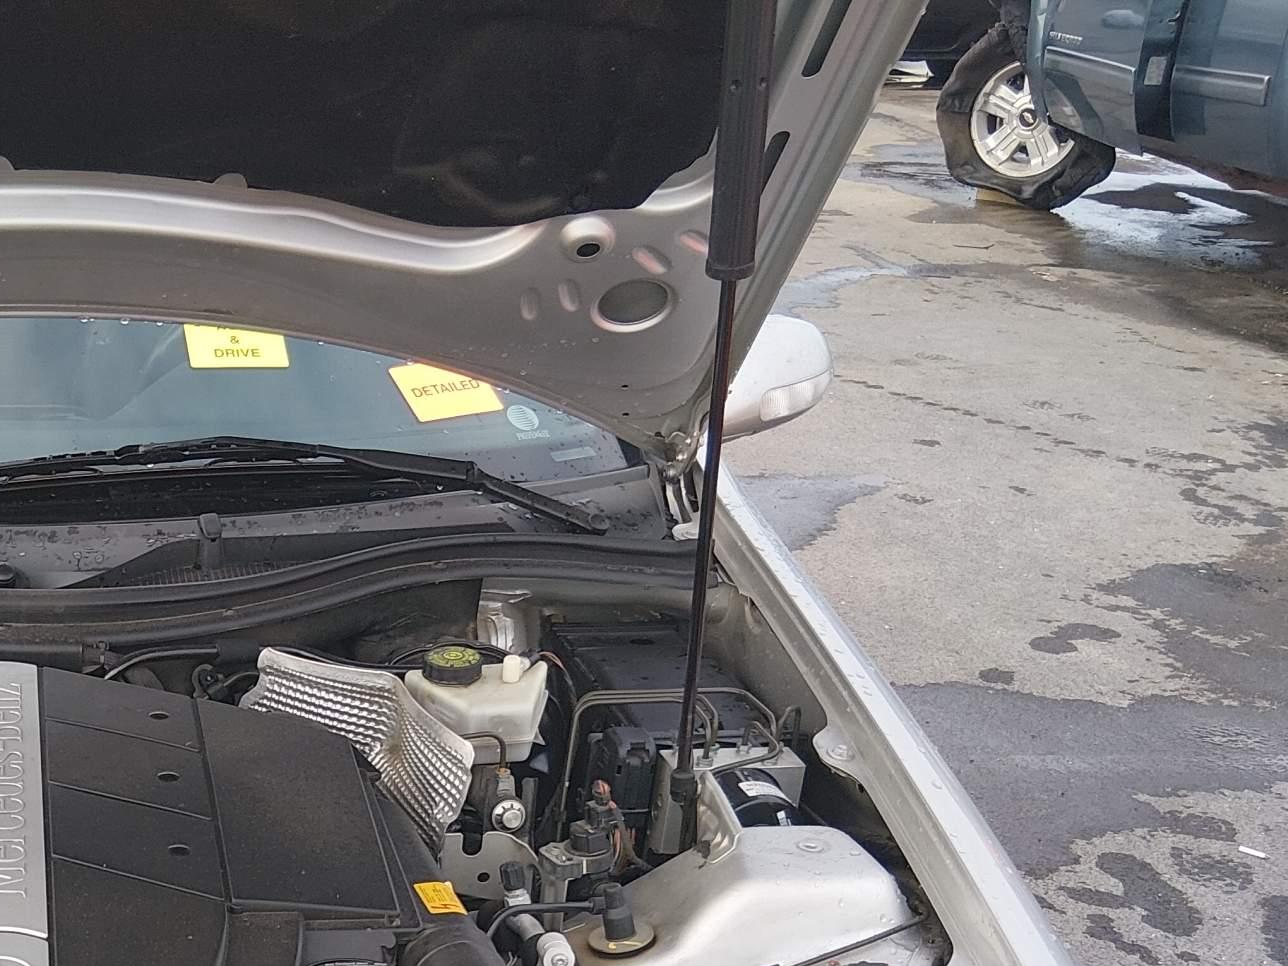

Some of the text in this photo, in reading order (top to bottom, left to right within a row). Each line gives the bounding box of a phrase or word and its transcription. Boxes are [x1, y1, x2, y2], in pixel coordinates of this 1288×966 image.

[230, 335, 240, 345] &
[214, 348, 261, 358] DRIVE
[410, 379, 481, 398] DETAILED
